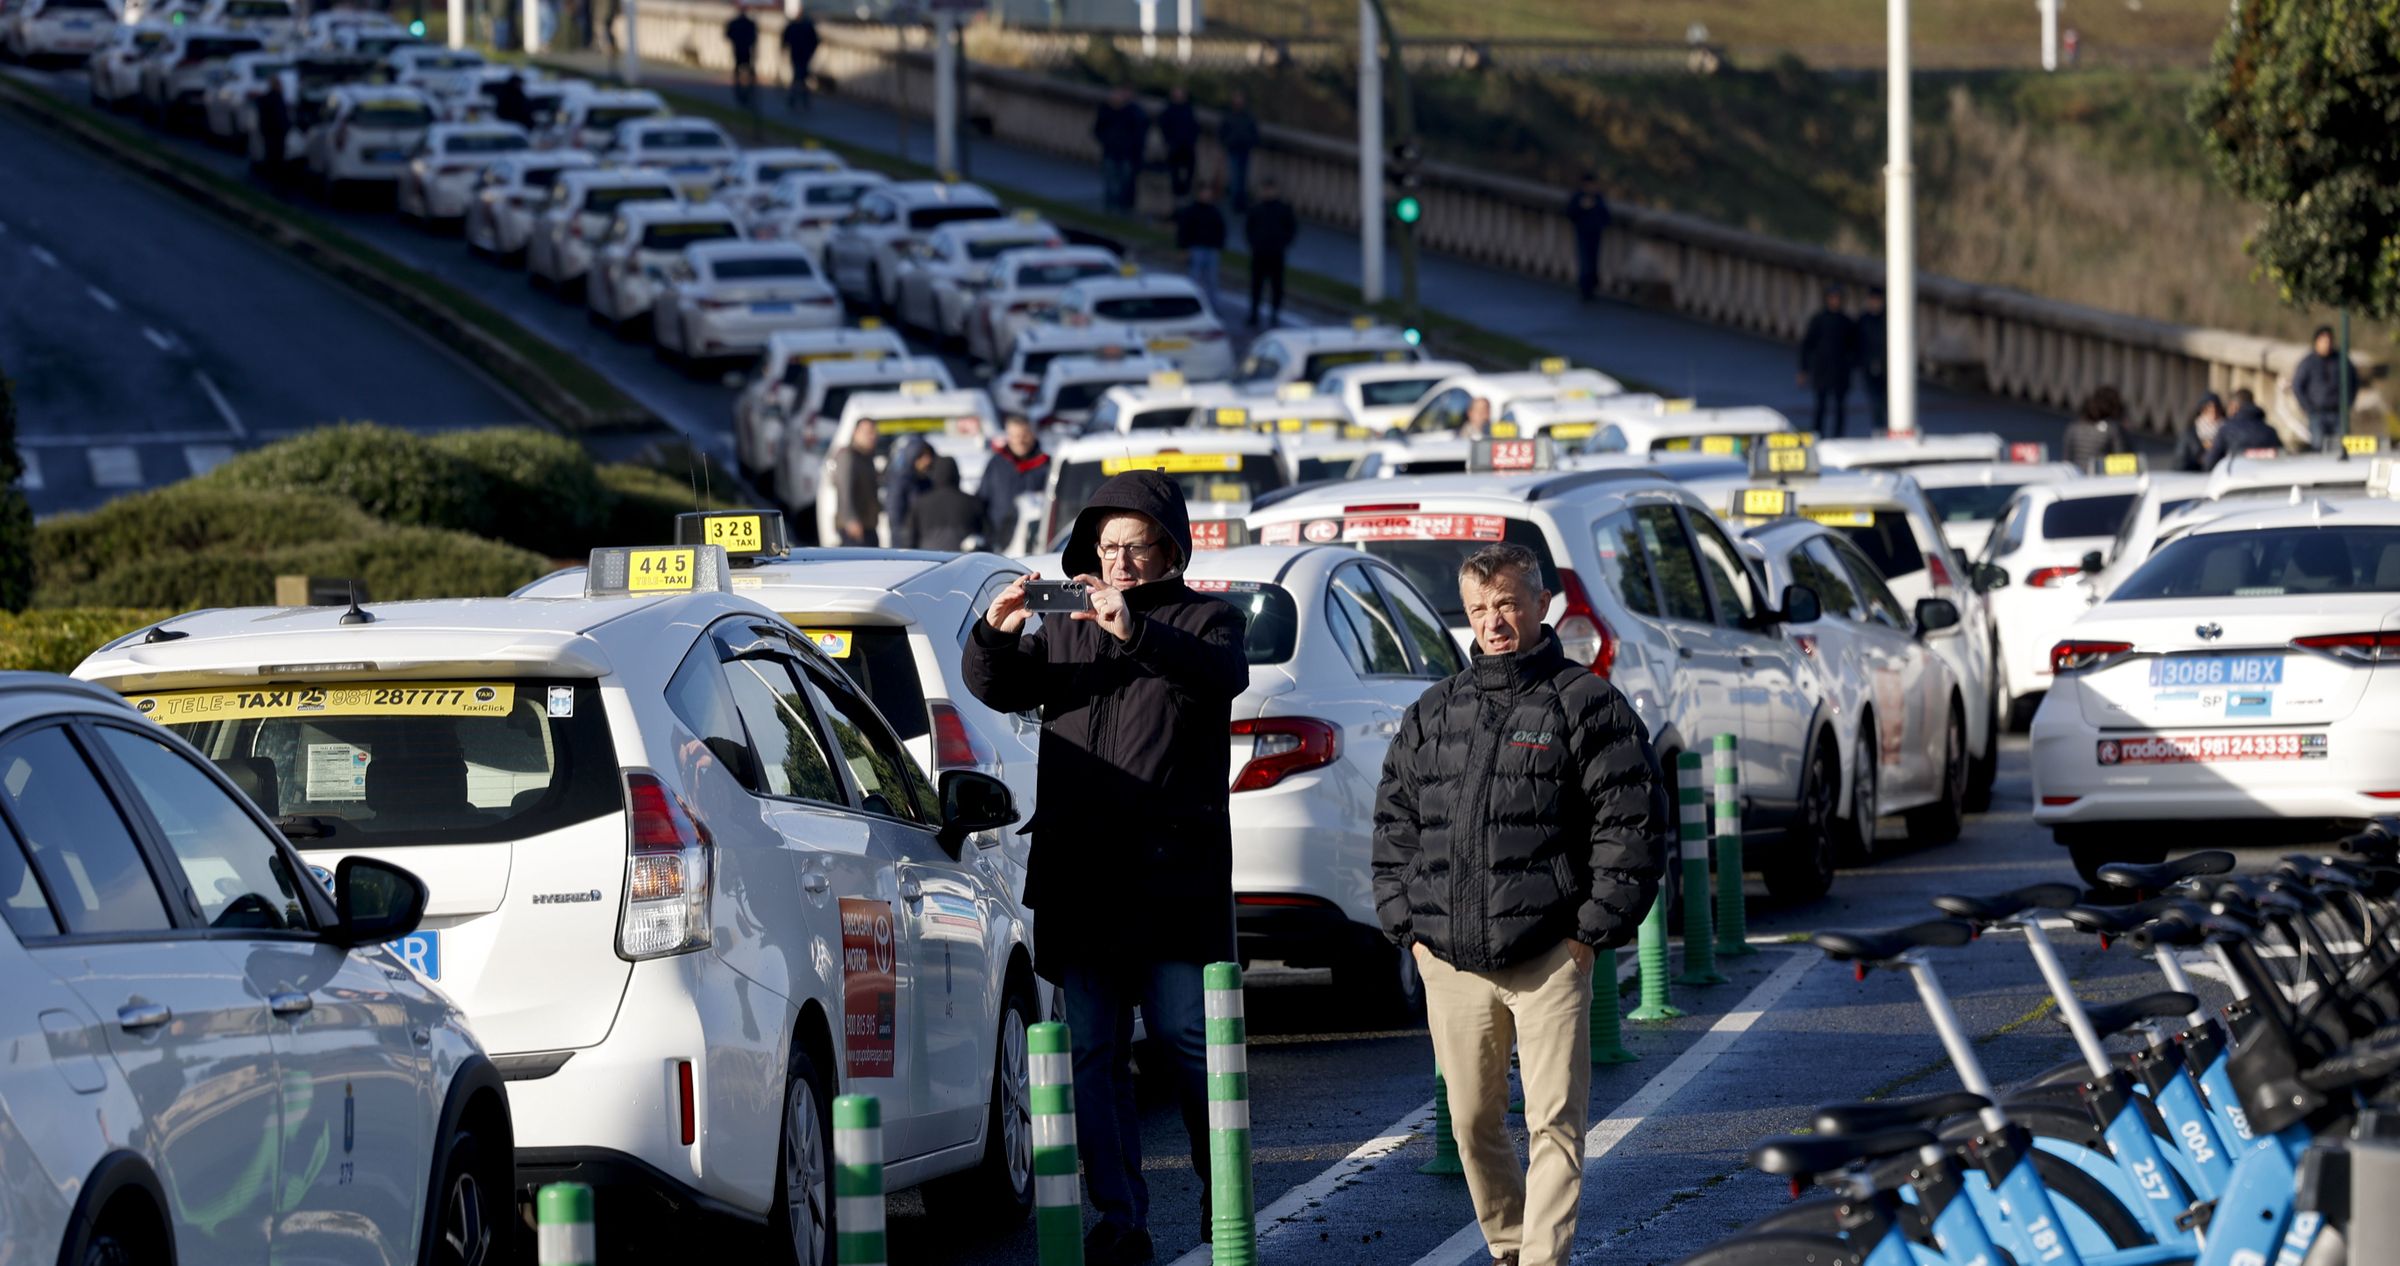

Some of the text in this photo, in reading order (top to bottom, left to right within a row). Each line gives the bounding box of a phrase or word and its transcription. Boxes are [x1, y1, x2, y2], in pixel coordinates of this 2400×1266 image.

[713, 521, 753, 538] 328
[639, 554, 686, 574] 445
[636, 575, 687, 586] TELE-TAXI
[2164, 659, 2276, 684] 3086 MBX
[167, 691, 294, 715] TELE-TAXI
[299, 689, 325, 706] 25
[477, 691, 493, 699] TAXI
[2203, 695, 2222, 708] SP
[462, 704, 505, 712] TaxiClick
[2121, 736, 2200, 759] radioTaxi
[532, 893, 591, 905] HYBRID
[842, 908, 874, 937] BREOGÁN
[845, 948, 869, 972] MOTOR
[2180, 1119, 2215, 1165] 004
[2132, 1157, 2171, 1201] 257
[2026, 1214, 2065, 1263] 181
